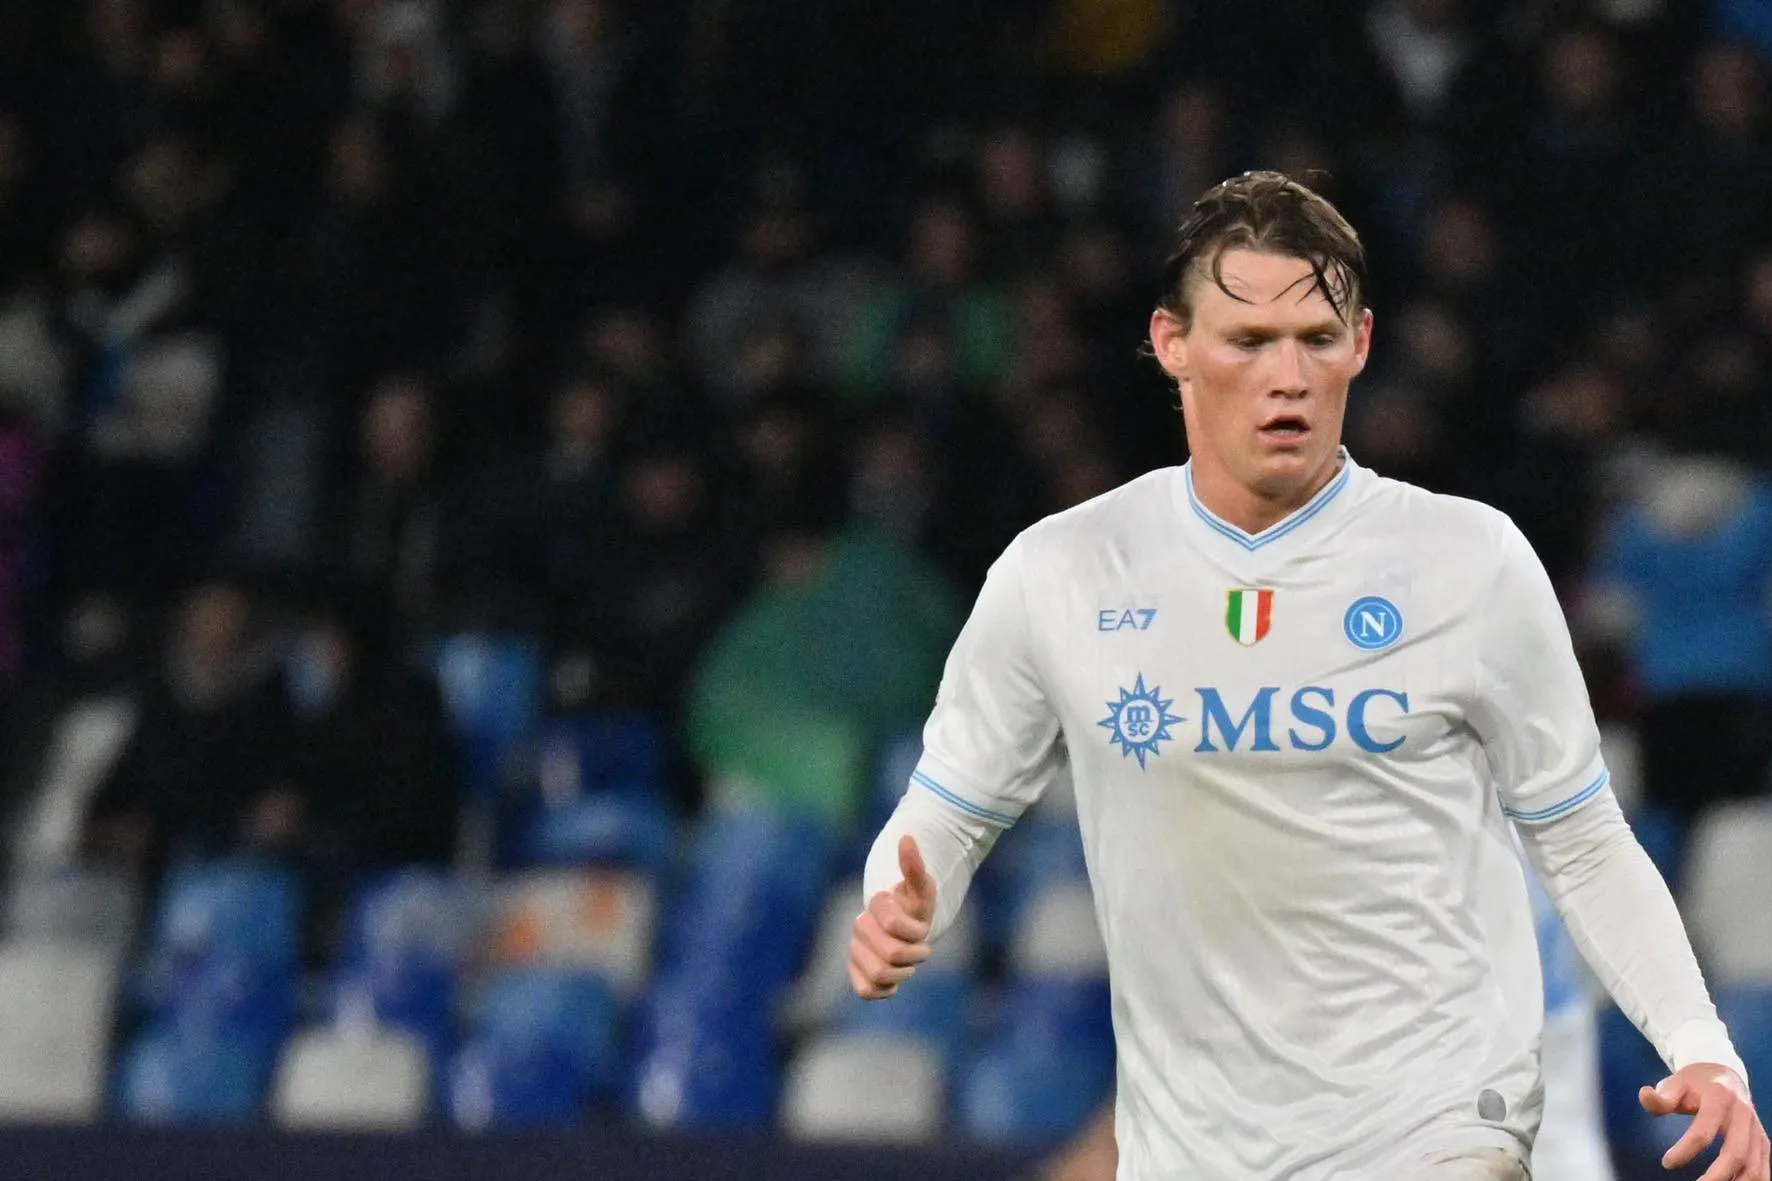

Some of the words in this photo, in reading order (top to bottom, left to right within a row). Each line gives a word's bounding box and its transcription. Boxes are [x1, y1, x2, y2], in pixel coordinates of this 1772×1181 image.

[1099, 608, 1158, 631] EA7
[1360, 611, 1387, 638] N
[1194, 686, 1410, 753] MSC
